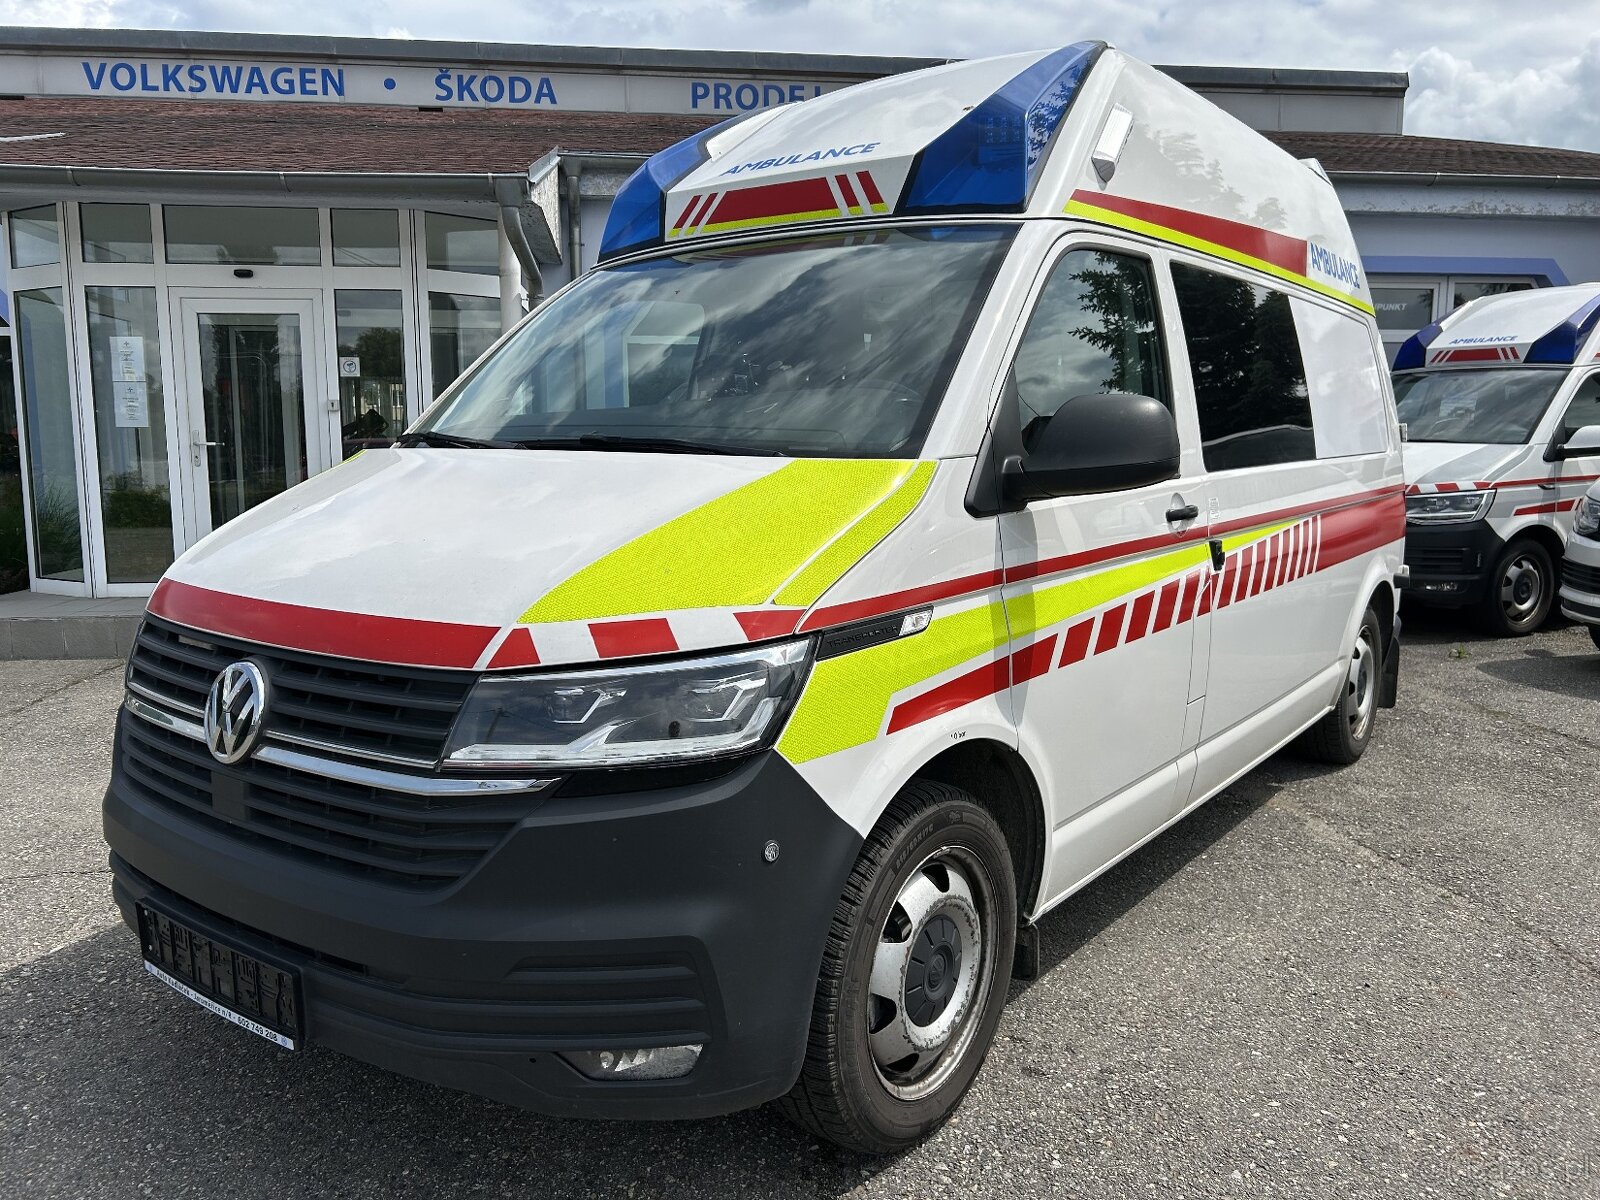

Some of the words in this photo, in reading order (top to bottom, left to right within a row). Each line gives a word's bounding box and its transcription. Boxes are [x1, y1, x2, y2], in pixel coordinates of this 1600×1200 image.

[81, 62, 345, 96] VOLKSWAGEN
[434, 69, 558, 105] ŠKODA
[719, 142, 881, 177] AMBULANCE
[1310, 242, 1361, 289] AMBULANCE
[1375, 303, 1407, 311] PUNKT
[1449, 335, 1518, 345] AMBULANCE
[827, 624, 899, 648] TRANSPORTER
